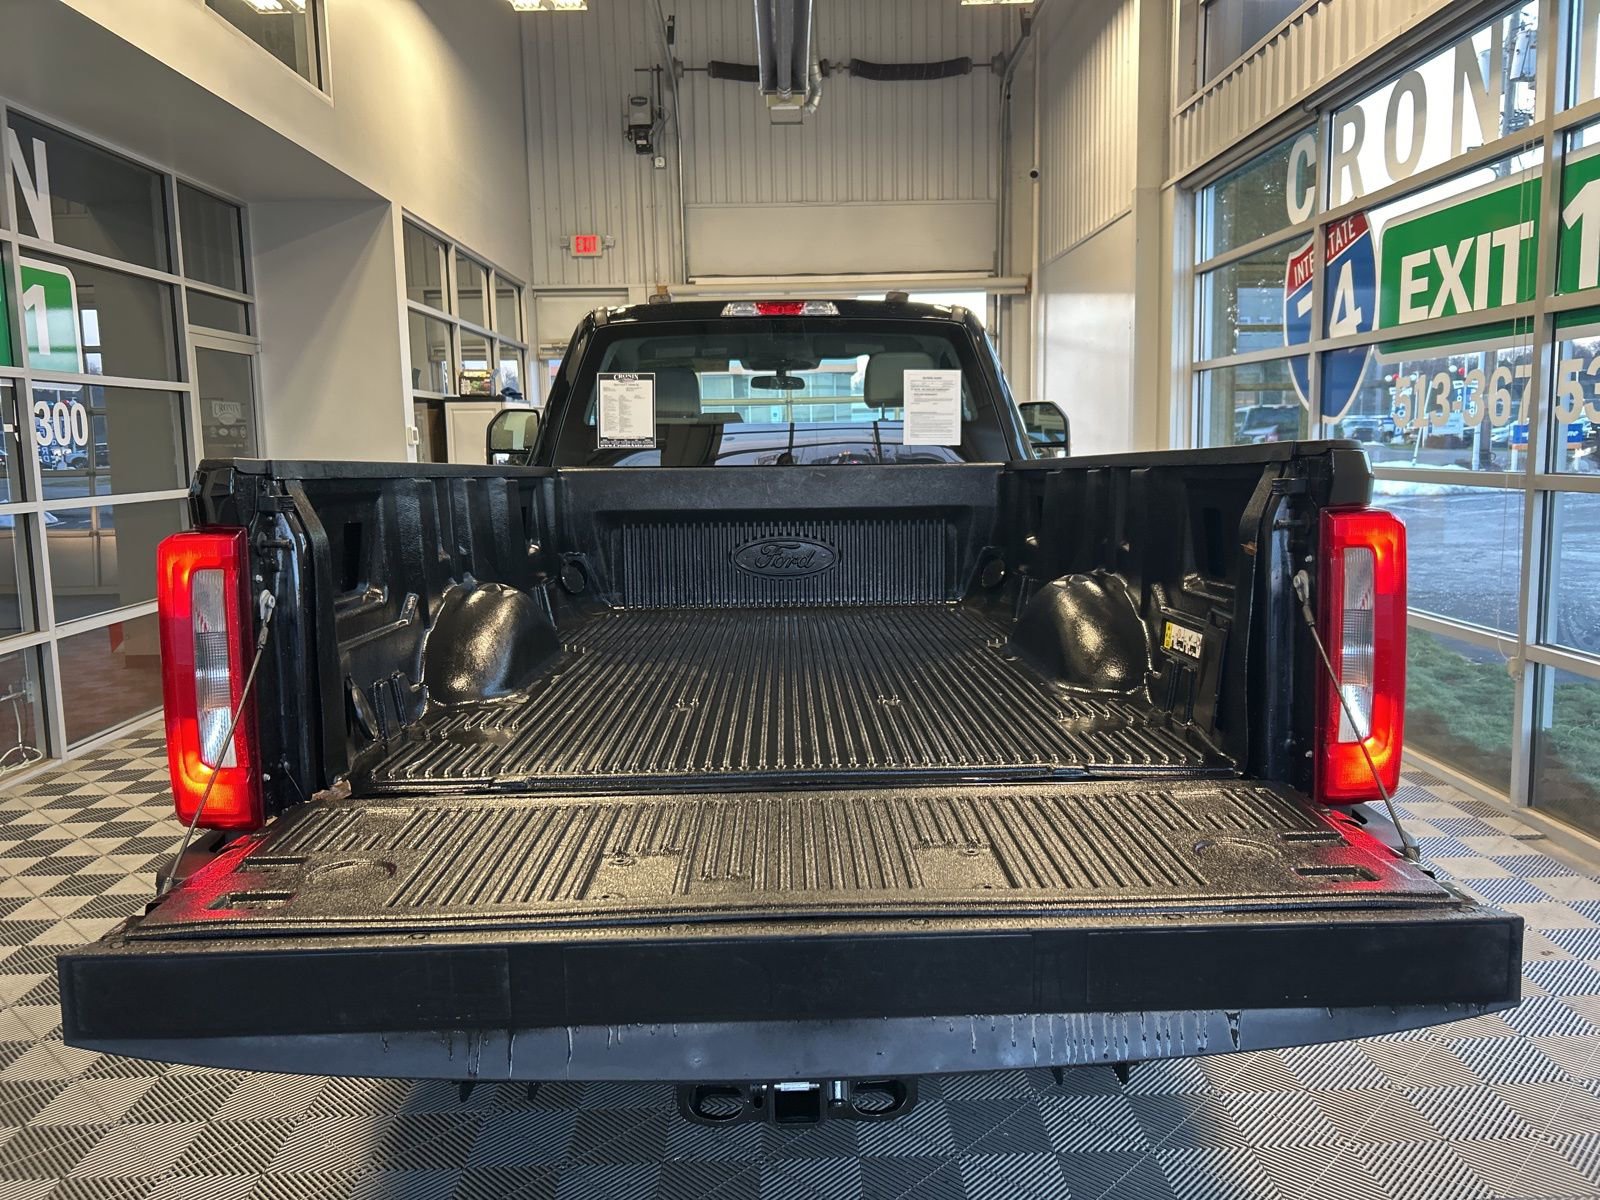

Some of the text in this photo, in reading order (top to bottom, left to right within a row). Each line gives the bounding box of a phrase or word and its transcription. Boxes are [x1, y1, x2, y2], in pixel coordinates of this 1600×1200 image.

[1293, 217, 1356, 287] INTETATE
[1399, 220, 1535, 325] EXIT
[23, 284, 50, 356] 1
[755, 544, 816, 568] Ford
